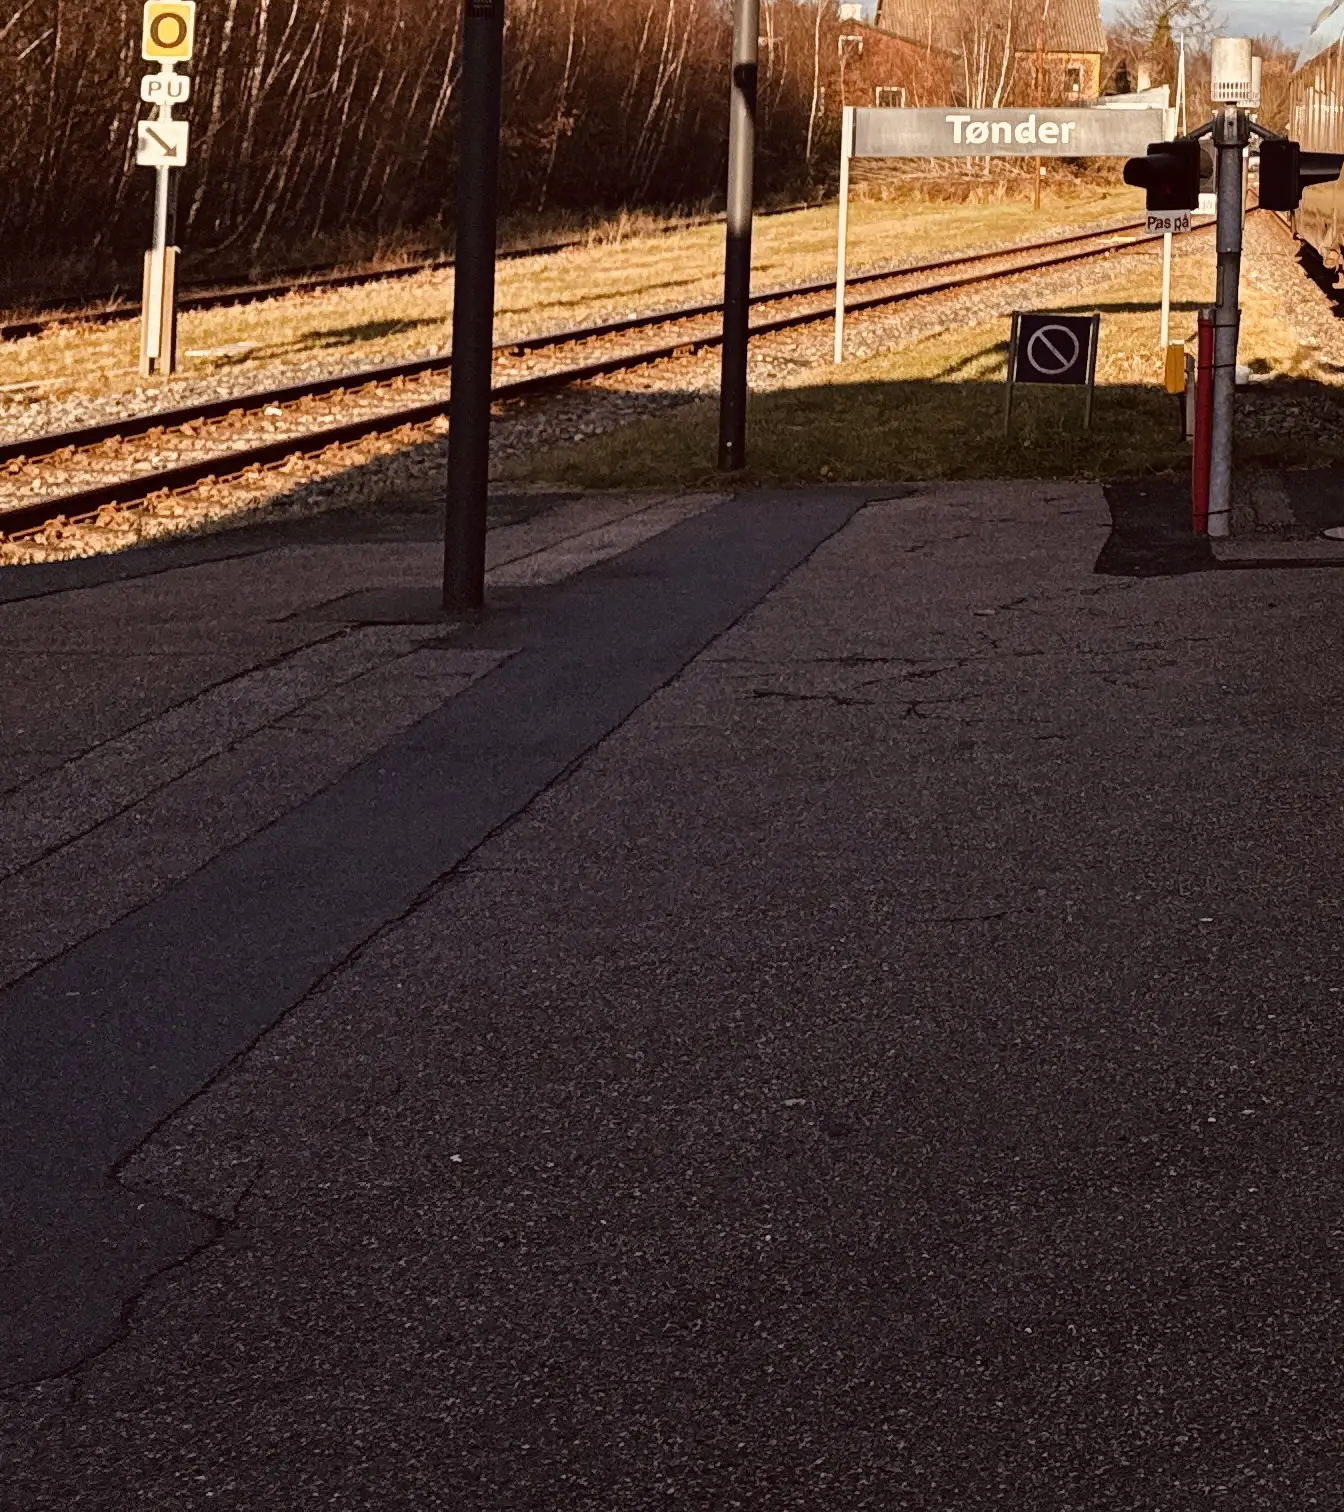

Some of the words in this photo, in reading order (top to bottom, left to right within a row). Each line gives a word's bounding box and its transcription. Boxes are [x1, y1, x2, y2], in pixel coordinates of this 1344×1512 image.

[147, 80, 183, 98] PU
[945, 113, 1076, 145] Tønder
[1147, 215, 1172, 230] Pas
[1173, 211, 1190, 232] på
